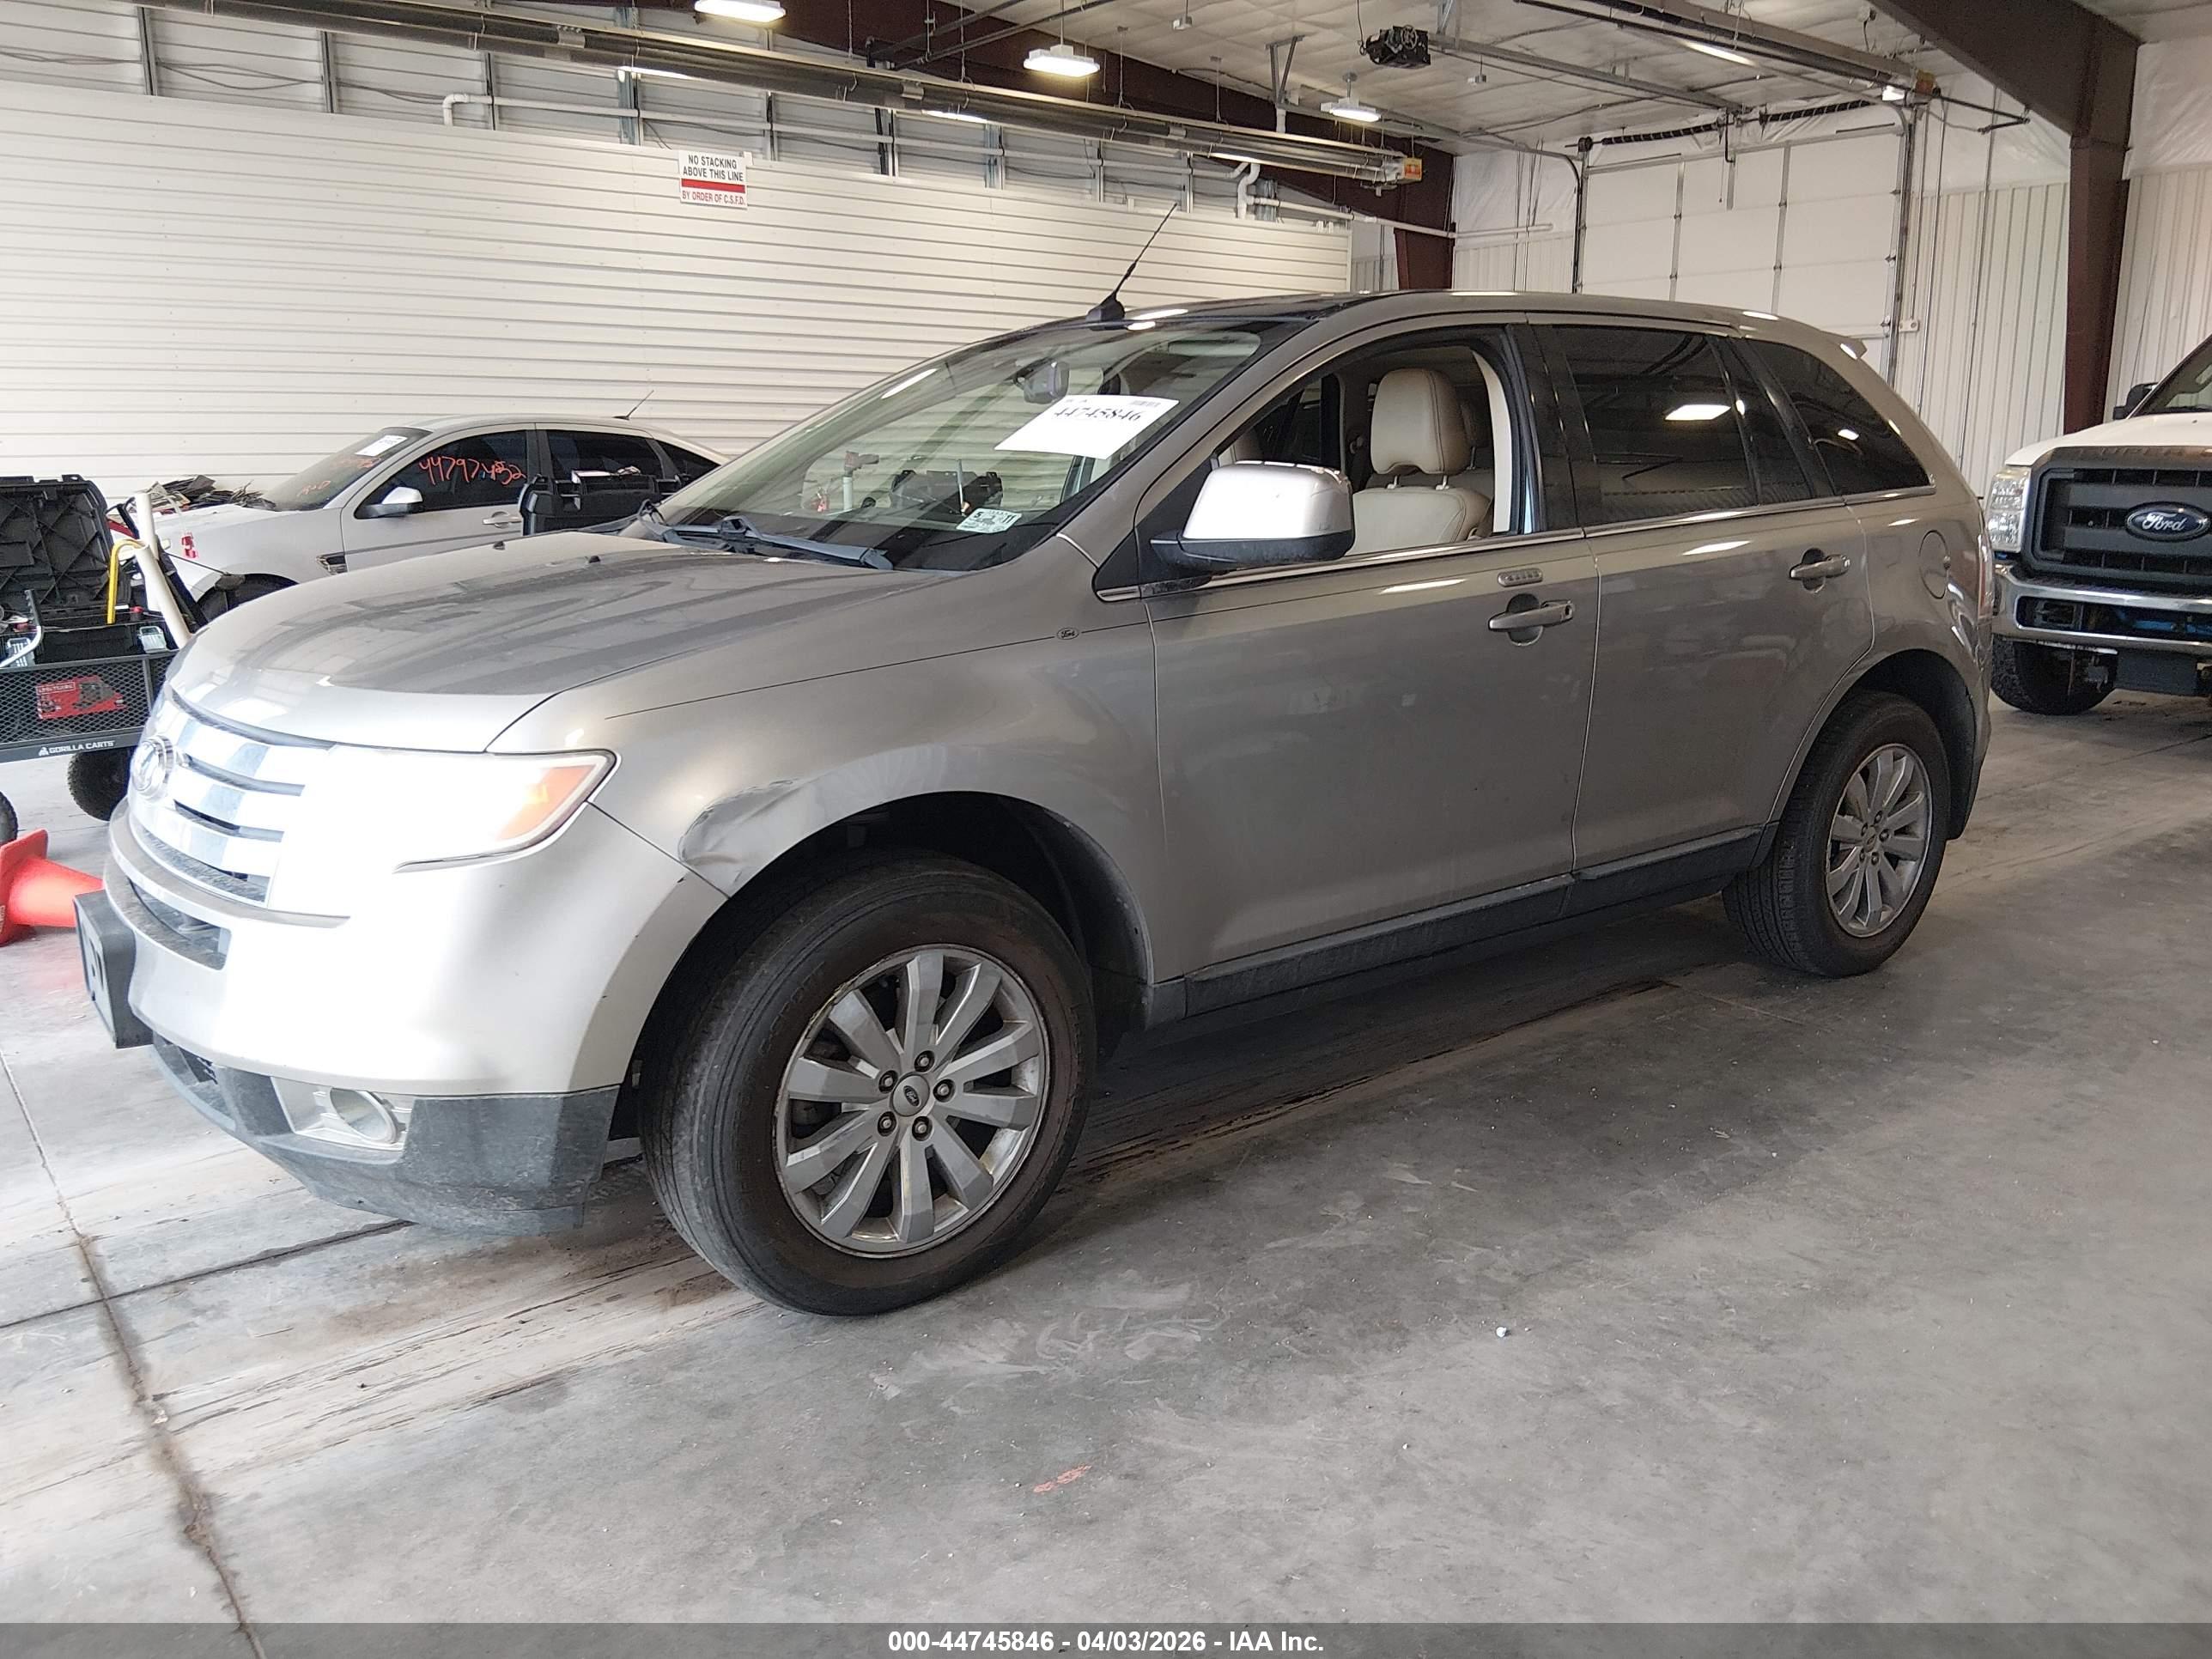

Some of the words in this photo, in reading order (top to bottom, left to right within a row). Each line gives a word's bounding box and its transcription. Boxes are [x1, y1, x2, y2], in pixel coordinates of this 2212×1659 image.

[688, 155, 699, 165] NO
[701, 156, 737, 169] STACKING
[683, 167, 707, 178] ABOVE
[709, 169, 726, 180] THIS
[727, 172, 744, 181] LINE
[682, 190, 690, 200] BY
[692, 191, 713, 202] ORDER
[714, 194, 722, 204] OF
[2142, 511, 2188, 531] Ford
[48, 744, 84, 754] GORILLA
[86, 741, 114, 750] CARTS
